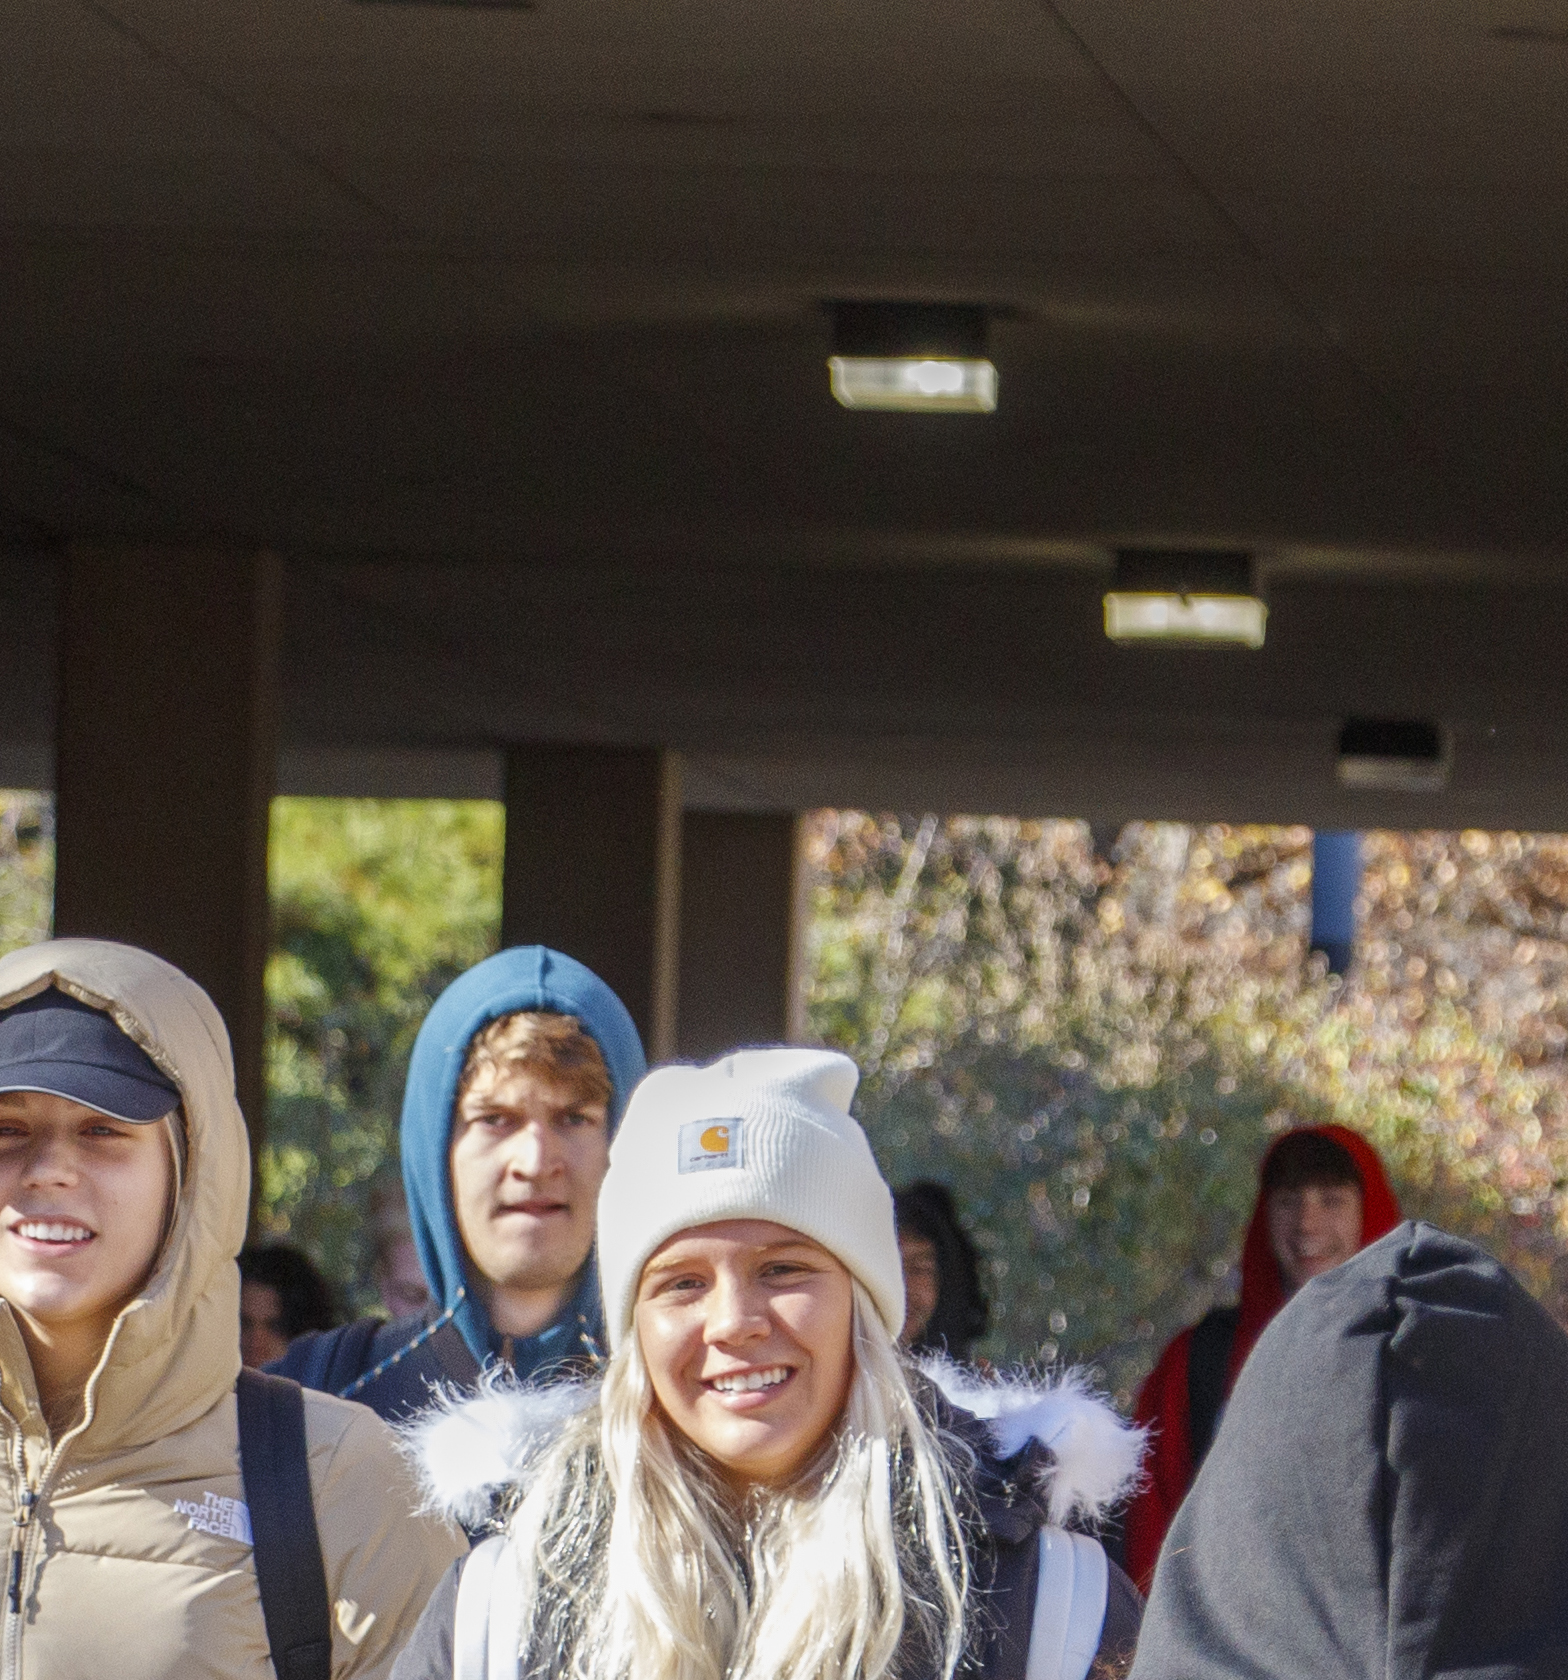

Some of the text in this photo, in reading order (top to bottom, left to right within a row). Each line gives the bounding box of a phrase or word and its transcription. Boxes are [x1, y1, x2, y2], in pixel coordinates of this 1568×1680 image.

[173, 1498, 231, 1523] NORTH
[203, 1490, 233, 1510] THE
[187, 1516, 231, 1537] FACE
